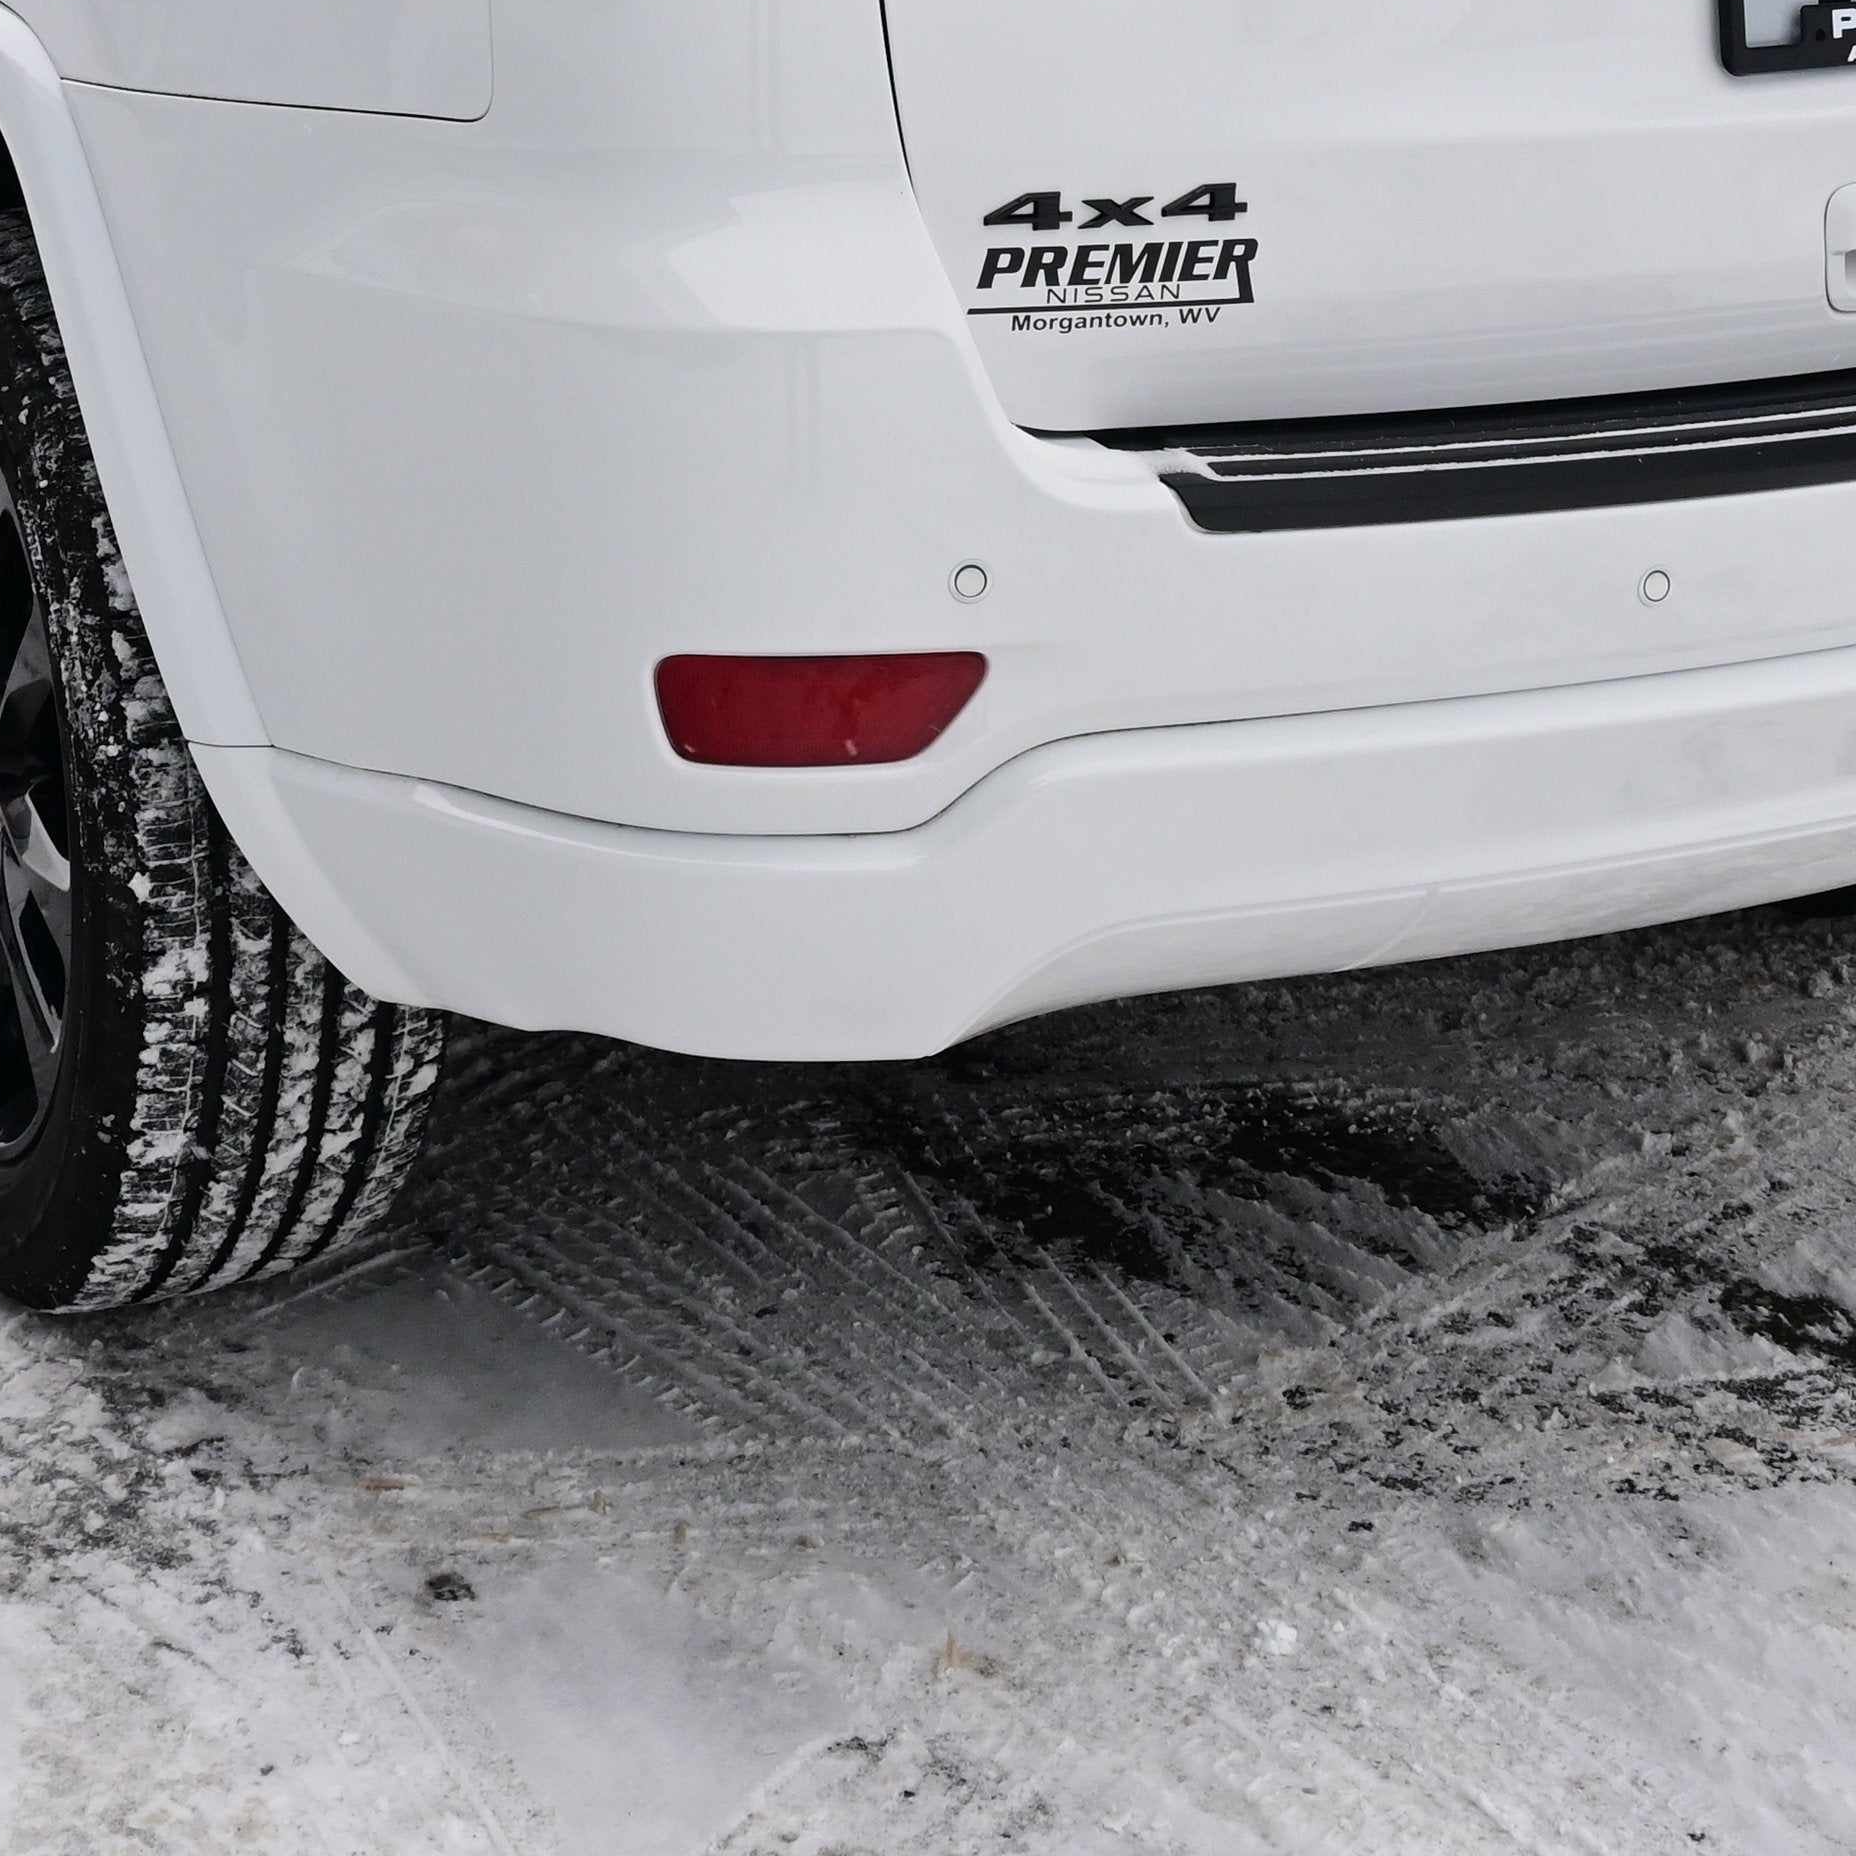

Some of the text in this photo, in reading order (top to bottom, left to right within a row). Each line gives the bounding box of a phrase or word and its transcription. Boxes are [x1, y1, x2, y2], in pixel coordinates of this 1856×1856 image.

[983, 182, 1248, 231] 4x4
[976, 238, 1259, 291] PREMIER
[1046, 283, 1181, 305] NISSAN
[1011, 307, 1221, 334] Morgantown, WV
